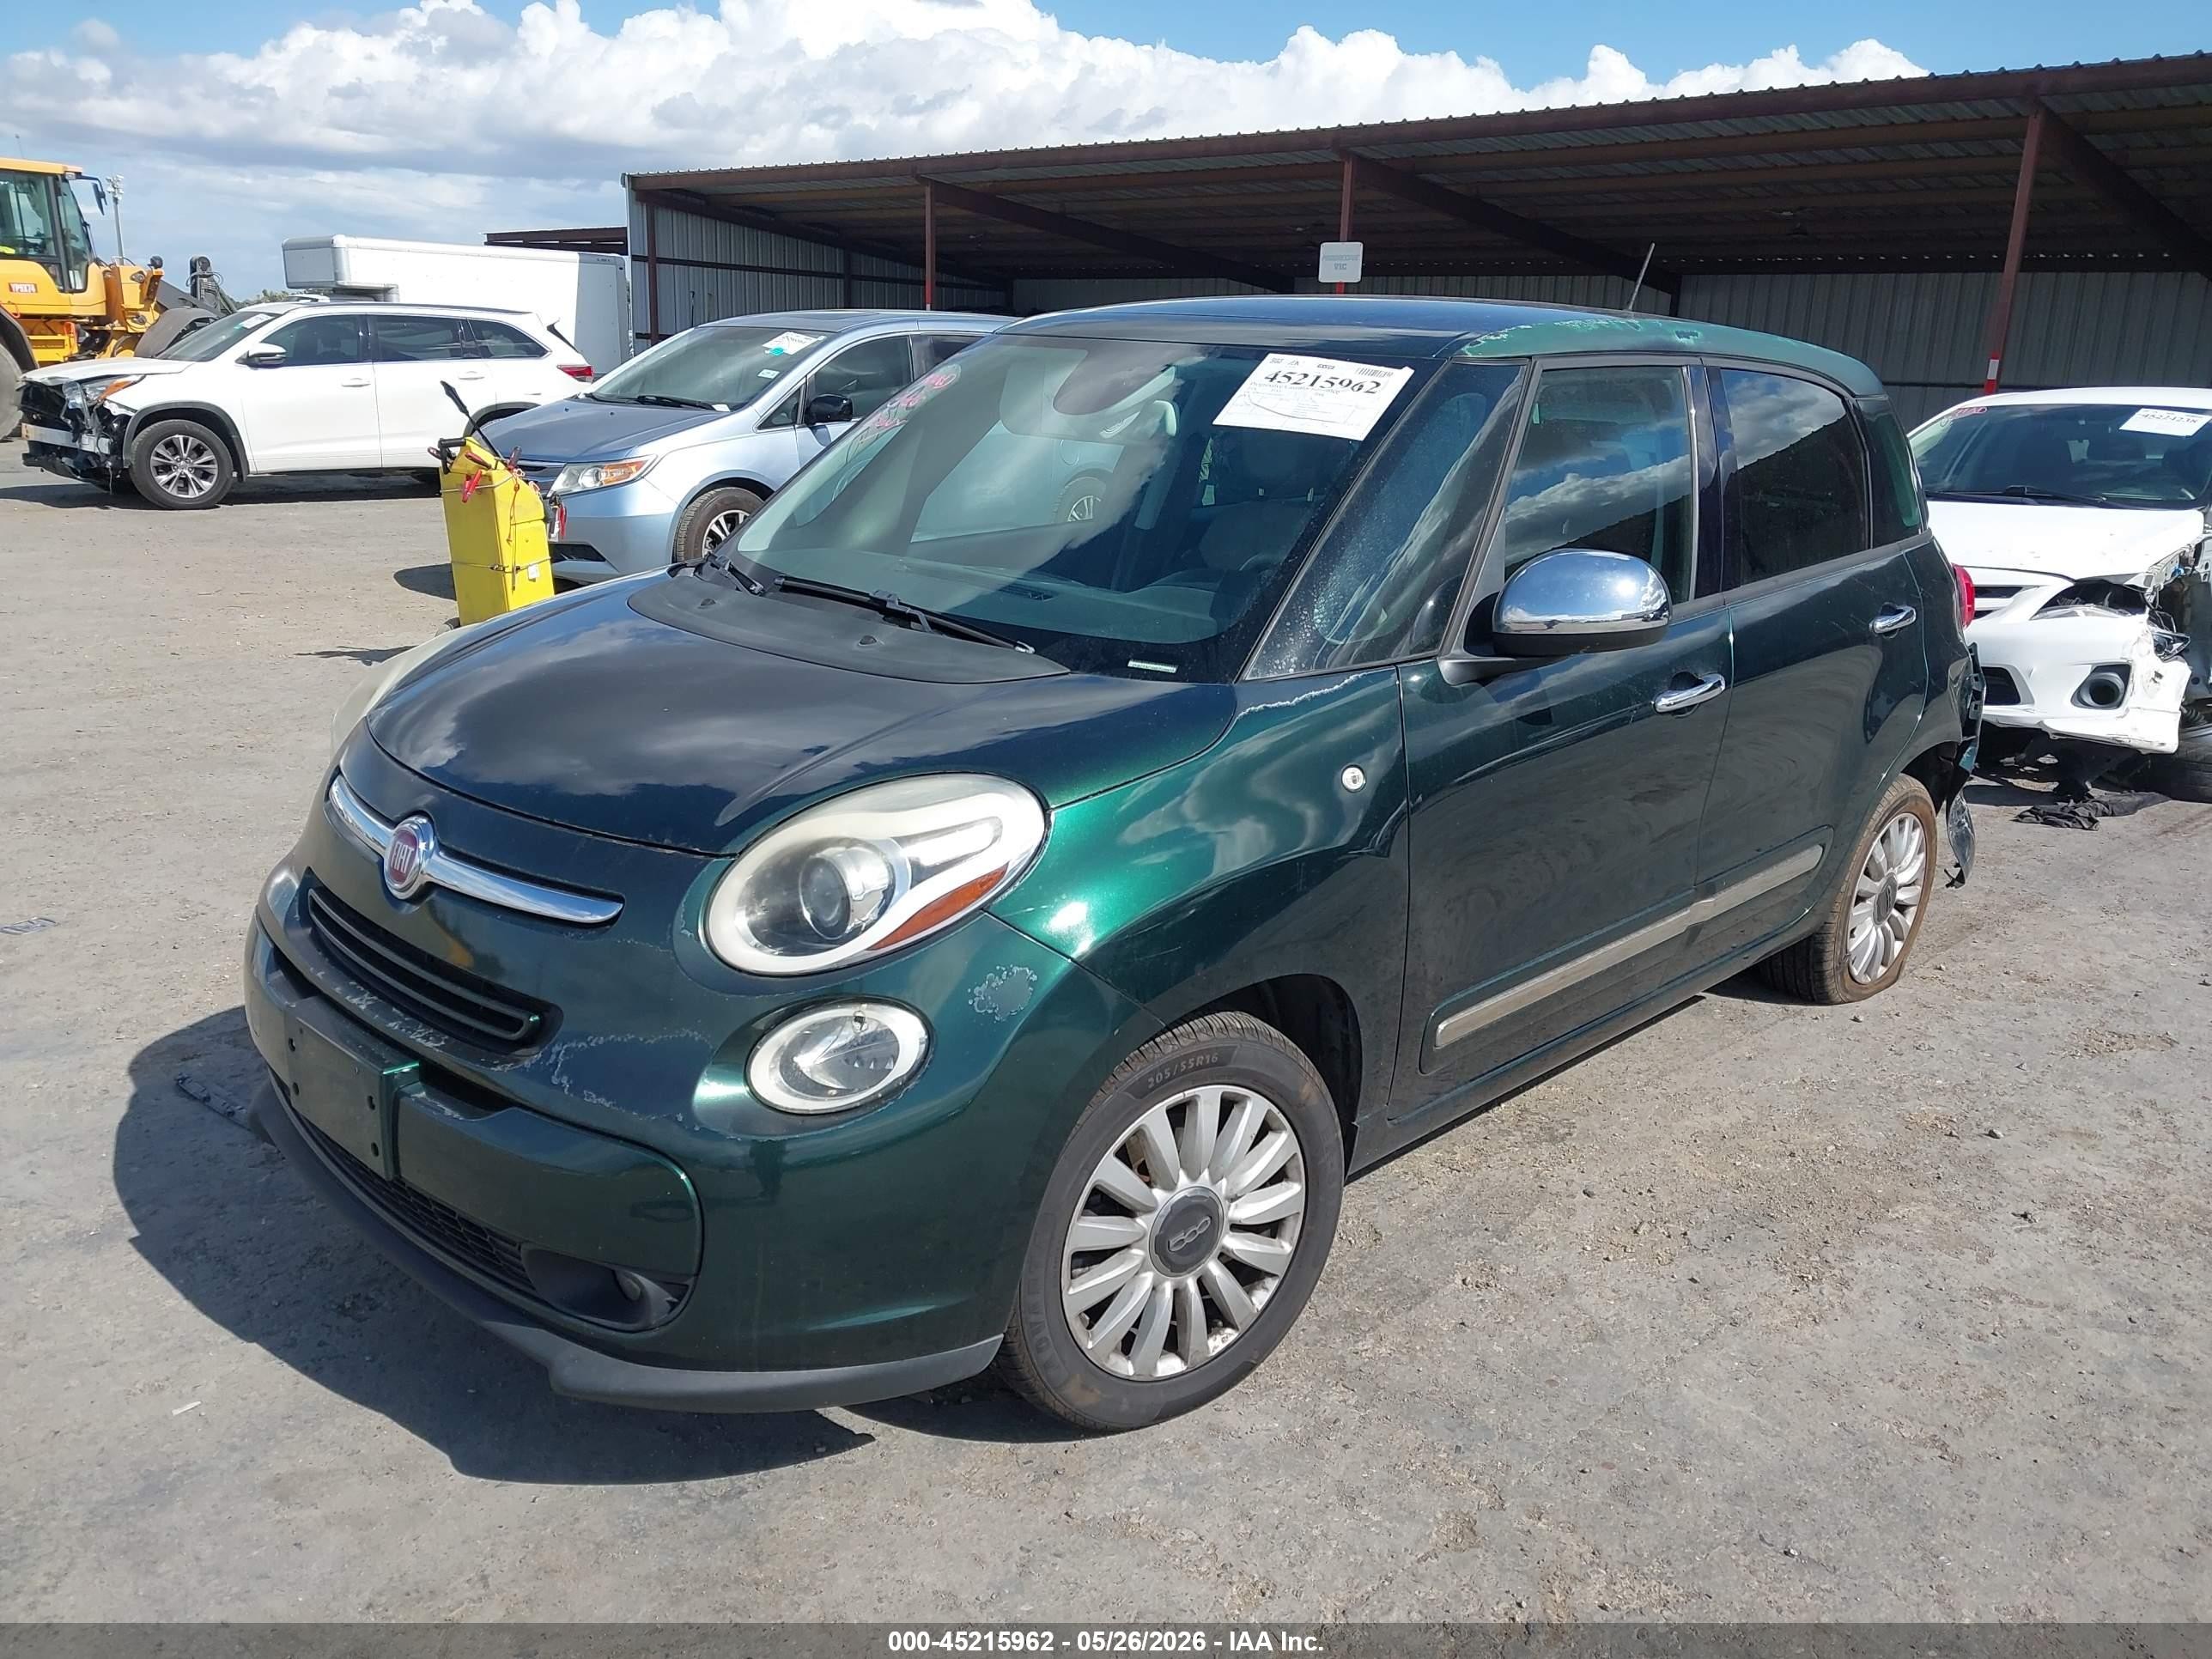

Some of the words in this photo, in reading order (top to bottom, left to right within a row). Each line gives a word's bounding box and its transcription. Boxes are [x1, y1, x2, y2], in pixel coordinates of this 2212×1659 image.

[1264, 370, 1381, 394] 45215962
[391, 841, 415, 874] FIAT
[1147, 1053, 1218, 1089] 205/55R16
[1169, 1216, 1211, 1252] 500
